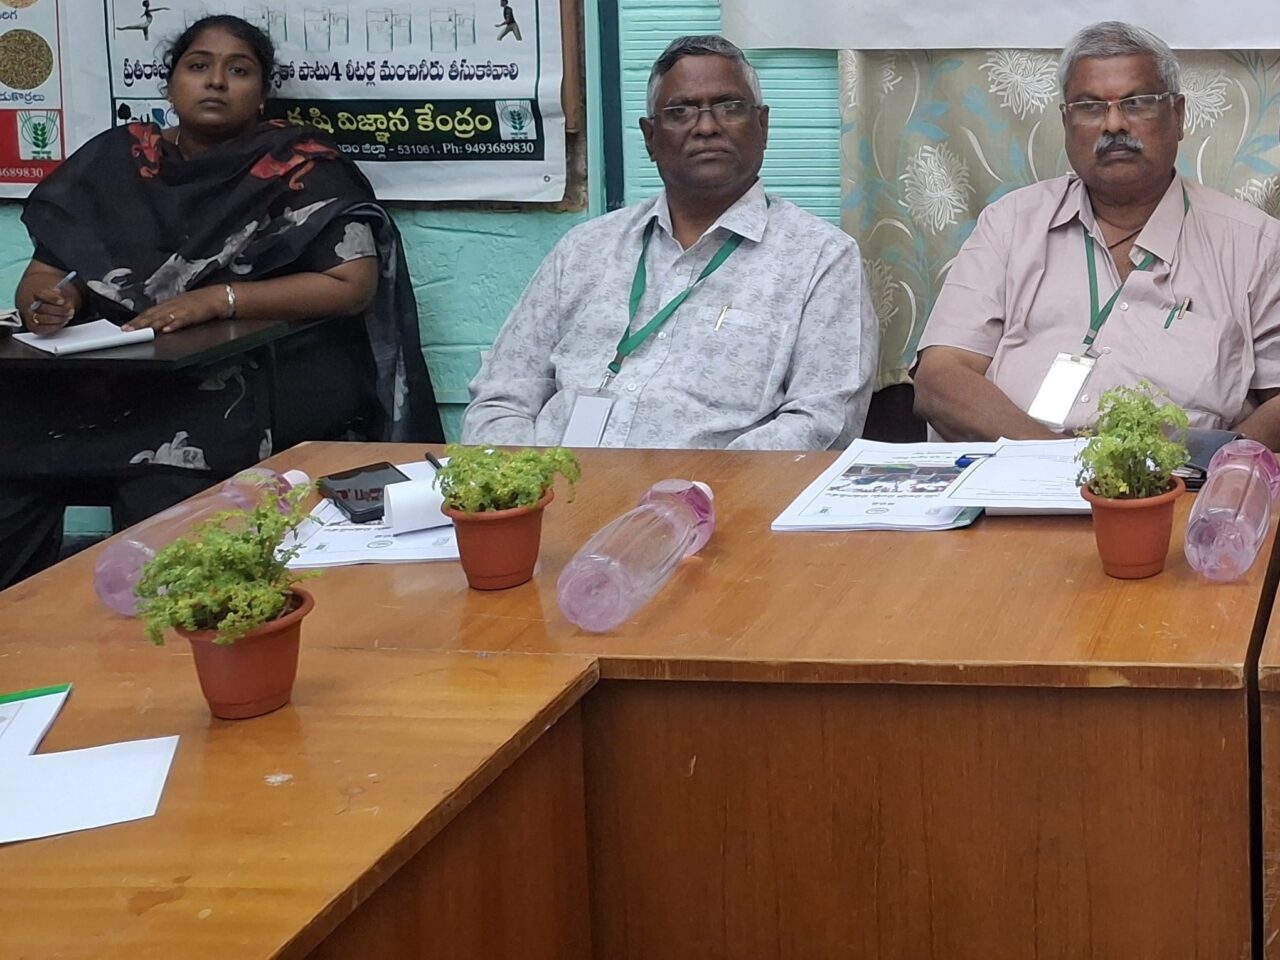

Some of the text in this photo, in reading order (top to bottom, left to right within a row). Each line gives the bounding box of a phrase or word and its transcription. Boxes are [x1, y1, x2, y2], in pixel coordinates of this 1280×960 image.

[448, 59, 519, 81] తీసుకోవాలి
[337, 103, 493, 144] విజ్ఞాన కేంద్రం
[442, 143, 463, 154] Ph:
[465, 142, 534, 154] 9493689830
[0, 168, 44, 178] 689830
